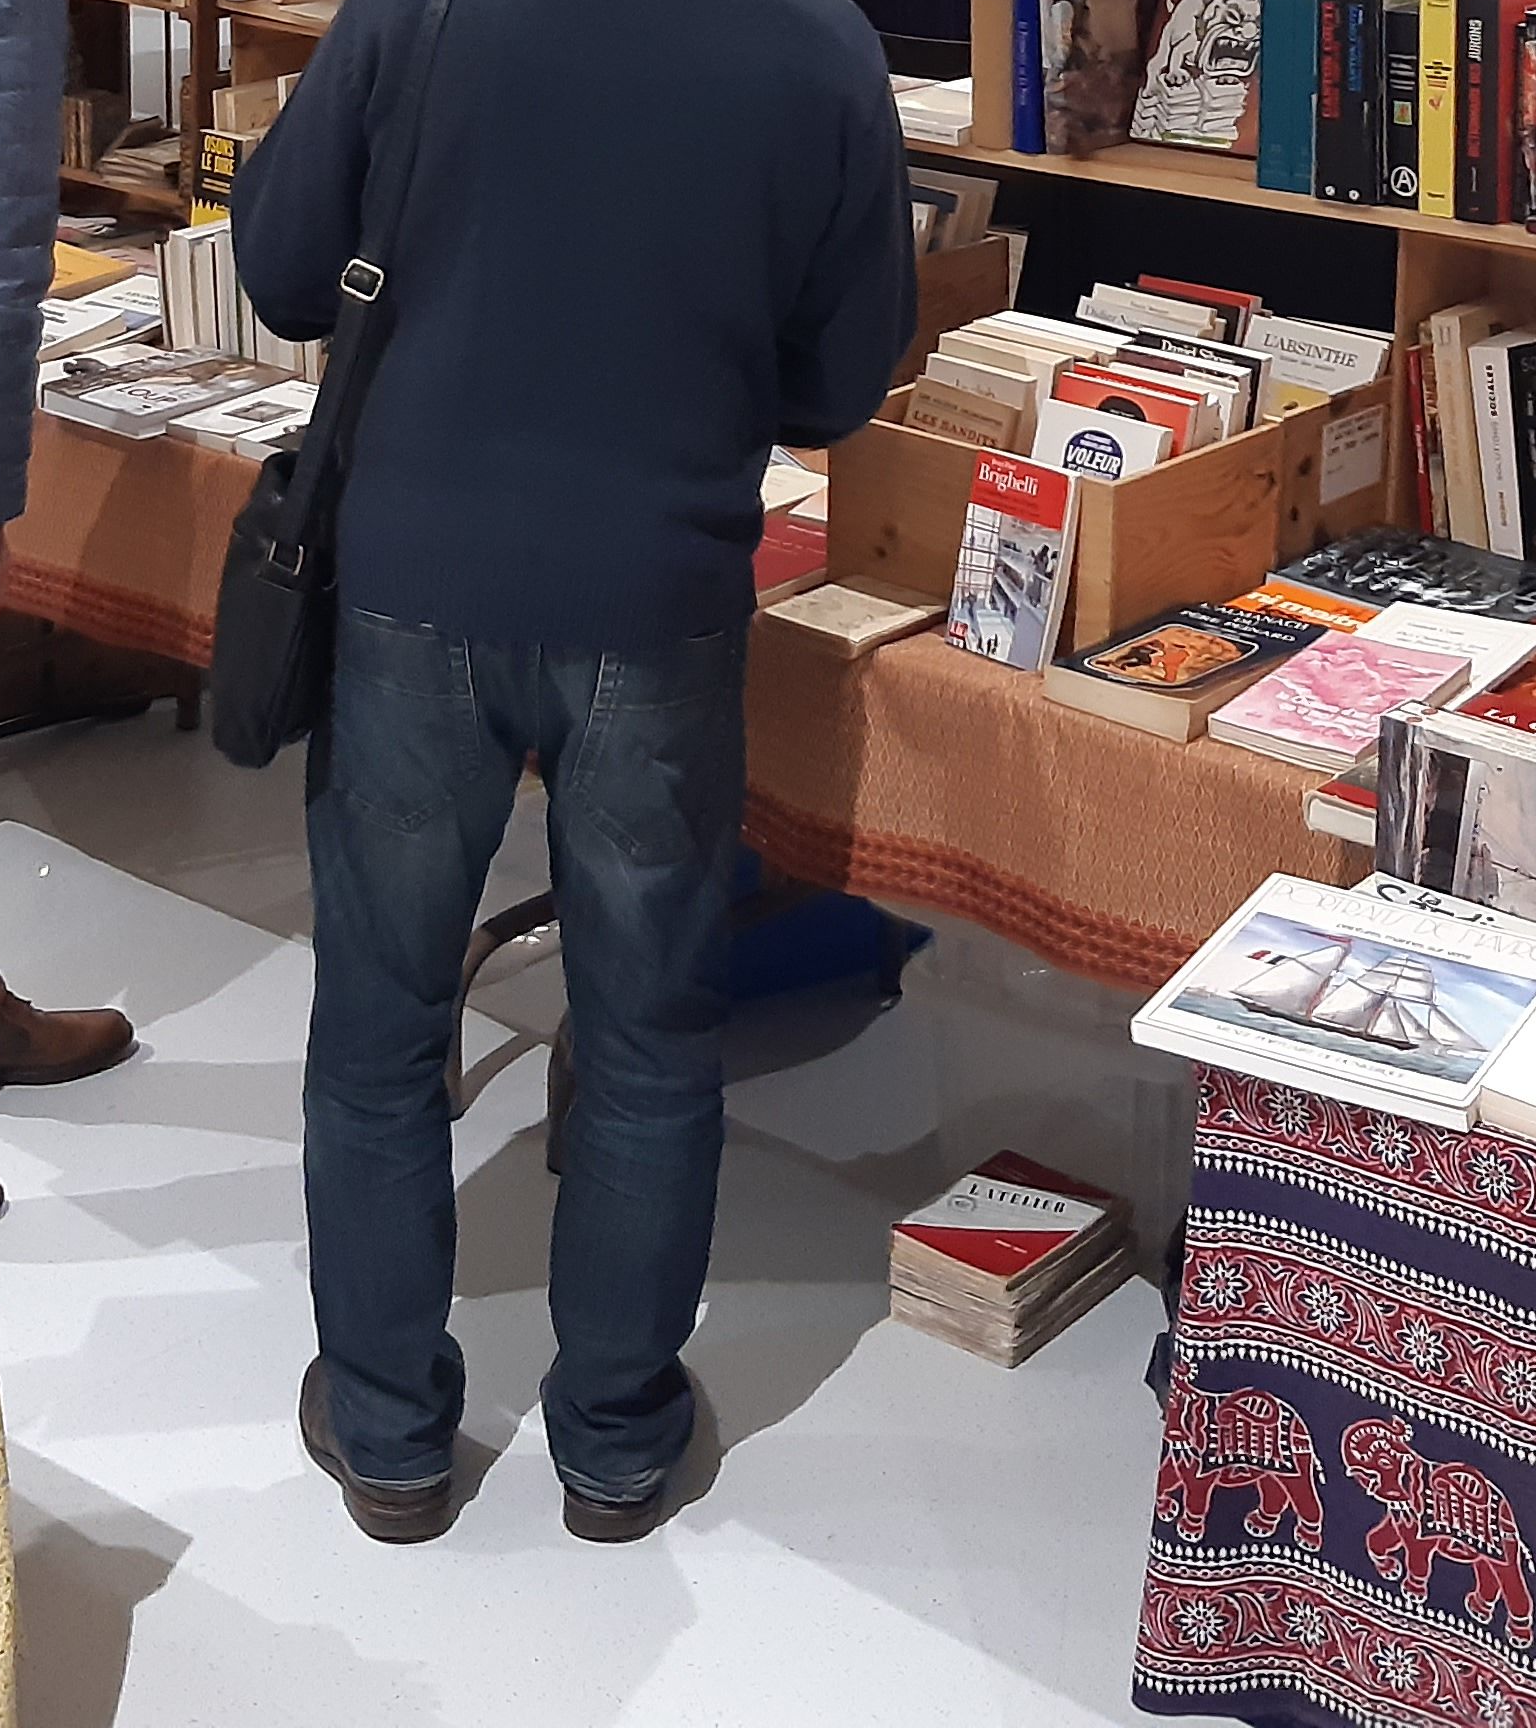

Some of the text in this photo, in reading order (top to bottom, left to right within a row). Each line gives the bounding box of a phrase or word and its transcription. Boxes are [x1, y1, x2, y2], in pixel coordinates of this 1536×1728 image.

[1468, 19, 1483, 61] JURONS
[1264, 333, 1359, 368] L'ABSINTHE
[1484, 364, 1498, 417] SOCIALES
[912, 409, 938, 426] LES
[1066, 445, 1123, 475] VOLEUR
[978, 463, 1039, 497] Brighelli
[1483, 707, 1517, 726] LA
